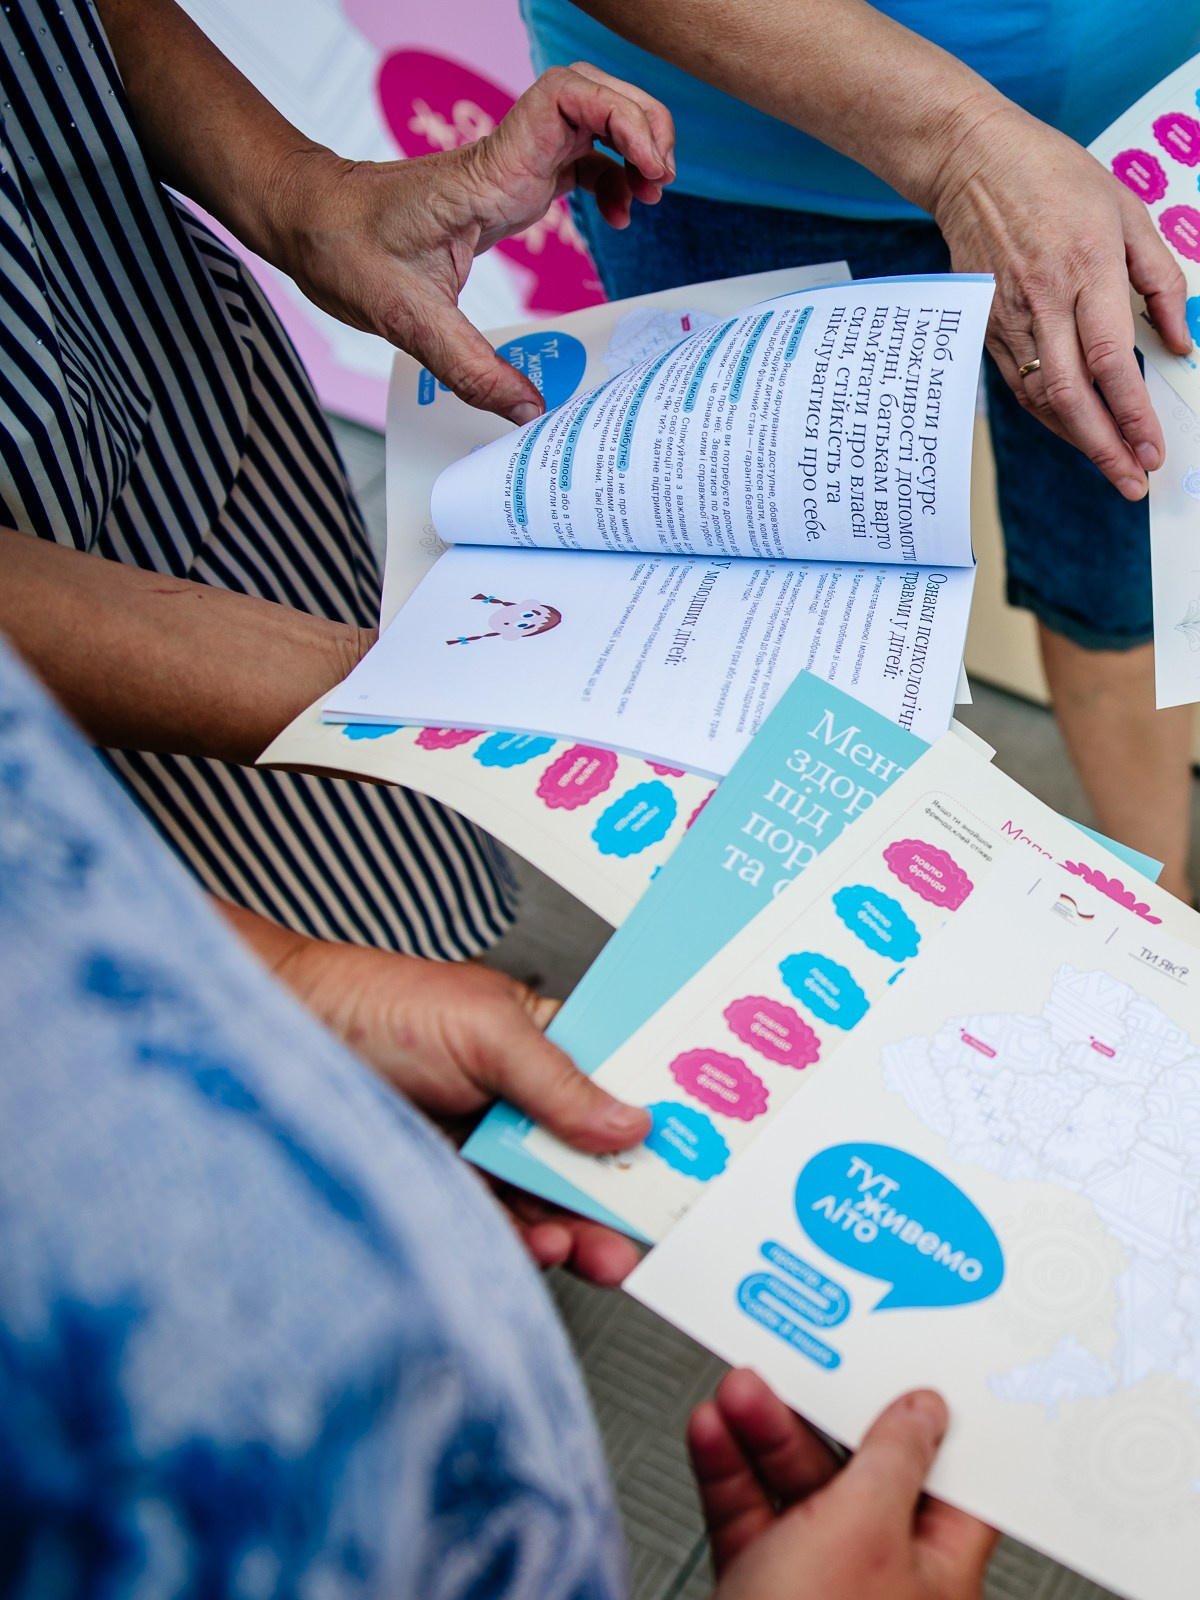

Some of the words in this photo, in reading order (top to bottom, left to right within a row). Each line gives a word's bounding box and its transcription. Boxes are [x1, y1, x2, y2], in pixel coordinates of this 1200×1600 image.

[837, 306, 867, 360] сили,
[878, 306, 911, 385] дитині,
[933, 309, 962, 362] Щоб
[777, 362, 792, 387] Якщо
[804, 306, 846, 440] піклуватися
[855, 306, 889, 416] пам'ятати
[750, 362, 766, 412] фізичний
[899, 319, 930, 463] можливості
[923, 368, 945, 431] мати
[703, 396, 714, 430] ознака
[724, 404, 738, 430] Якщо
[748, 412, 756, 436] стан
[770, 388, 786, 448] харчування
[828, 367, 851, 474] стійкість
[519, 453, 528, 466] до
[617, 419, 635, 471] майбутнє,
[652, 438, 662, 472] здатне
[676, 417, 691, 480] Спілкуйтеся
[700, 432, 708, 456] сили
[724, 434, 732, 446] ви
[756, 424, 769, 493] Намагайтеся
[847, 423, 867, 468] про
[874, 393, 900, 493] батькам
[504, 452, 520, 498] Контакти
[560, 446, 574, 490] сталося,
[606, 455, 616, 512] важливими
[618, 482, 626, 495] не
[664, 471, 672, 481] та
[709, 438, 721, 497] Звертатися
[720, 450, 730, 507] потребуєте
[744, 450, 752, 494] гарантія
[798, 447, 817, 491] про
[916, 434, 938, 516] ресурс
[514, 468, 526, 524] спеціаліста
[550, 476, 558, 506] могли
[550, 508, 559, 520] на
[561, 493, 571, 511] або
[594, 486, 604, 506] Такі
[618, 498, 627, 516] про
[710, 500, 718, 512] по
[827, 481, 841, 503] та
[850, 475, 867, 540] власні
[804, 497, 826, 542] себе.
[870, 503, 892, 550] варто
[682, 571, 720, 627] молодших
[899, 572, 919, 615] травми
[920, 573, 948, 623] Ознаки
[890, 618, 908, 630] у
[664, 629, 696, 666] дітей:
[883, 631, 910, 680] дітей:
[898, 626, 931, 732] психологічн
[786, 748, 878, 816] здор
[763, 778, 832, 837] під
[741, 812, 818, 870] пор
[721, 844, 766, 888] та
[908, 864, 946, 893] френда
[911, 854, 943, 879] ловлю
